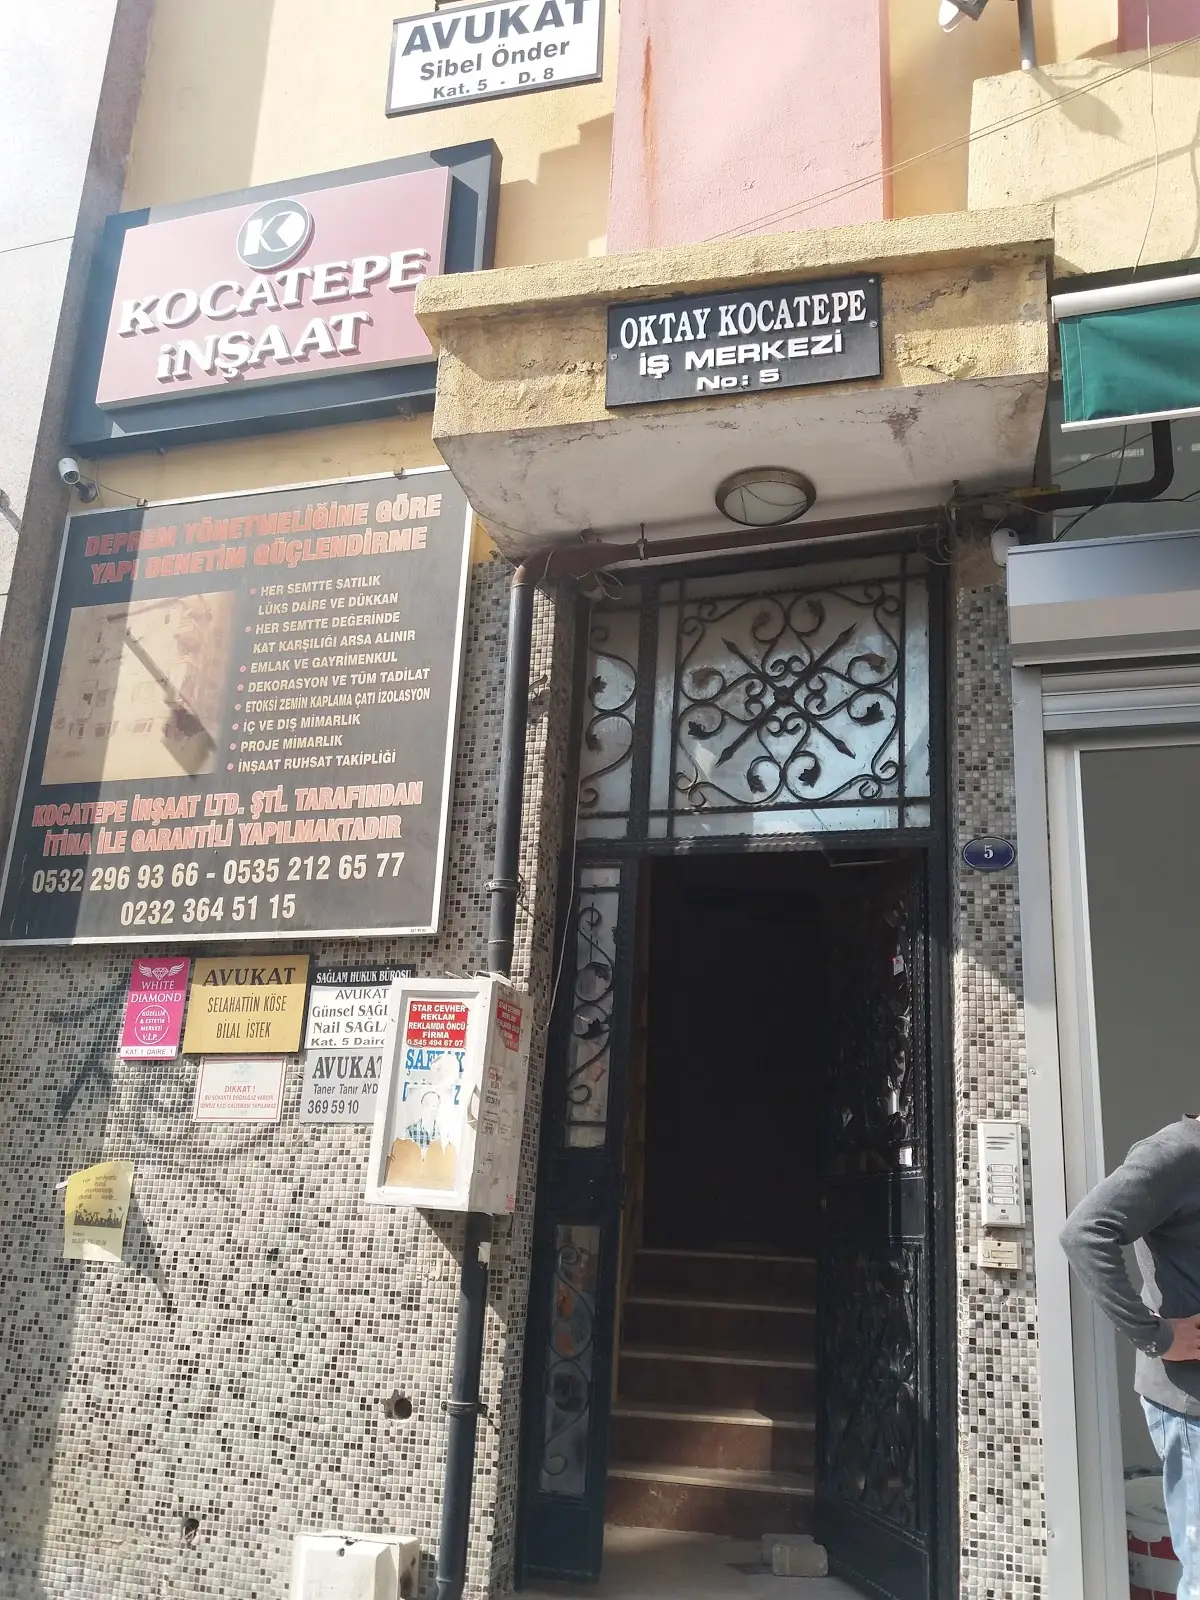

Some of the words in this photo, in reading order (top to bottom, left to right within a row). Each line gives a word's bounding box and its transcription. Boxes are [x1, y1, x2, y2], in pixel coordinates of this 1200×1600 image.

[402, 0, 591, 56] AVUKAT
[420, 53, 482, 80] Sibel
[492, 39, 570, 67] Önder
[433, 83, 469, 99] Kat.
[477, 79, 487, 91] 5
[518, 71, 535, 84] D.
[544, 68, 554, 79] 8
[117, 248, 431, 337] KOCATEPE
[620, 307, 711, 349] OKTAY
[718, 289, 867, 337] KOCATEPE
[639, 353, 669, 379] İŞ
[685, 329, 842, 370] MERKEZİ
[760, 369, 779, 383] 5
[85, 526, 176, 557] DEPREM
[185, 501, 368, 544] YÖNETMELİĞİNE
[376, 492, 443, 523] GÖRE
[91, 561, 139, 585] YAPI
[146, 543, 246, 579] DENETİM
[254, 526, 427, 568] GÜÇLENDİRME
[261, 585, 283, 596] HER
[287, 579, 332, 594] SEMTTE
[336, 575, 381, 589] SATILIK
[258, 602, 288, 616] LÜKS
[292, 598, 326, 612] DAİRE
[331, 598, 345, 608] VE
[348, 593, 398, 607] DÜKKAN
[256, 623, 279, 635] HER
[282, 618, 328, 633] SEMTTE
[332, 611, 400, 628] DEĞERİNDE
[253, 641, 274, 654] KAT
[279, 635, 336, 652] KARŞILIĞI
[340, 634, 371, 646] ARSA
[375, 630, 416, 643] ALINIR
[251, 659, 290, 674] EMLAK
[294, 659, 309, 669] VE
[312, 651, 398, 669] GAYRİMENKUL
[248, 676, 328, 693] DEKORASYON
[332, 675, 347, 686] VE
[351, 671, 376, 685] TÜM
[380, 667, 430, 683] TADİLAT
[279, 694, 308, 711] ZEMİN
[310, 693, 352, 708] KAPLAMA
[355, 692, 375, 708] ÇATI
[378, 687, 430, 704] İZOLASYON
[243, 718, 255, 735] İÇ
[259, 720, 274, 731] VE
[277, 717, 297, 732] DIŞ
[301, 713, 361, 728] MİMARLIK
[240, 739, 279, 752] PROJE
[283, 734, 343, 750] MİMARLIK
[238, 758, 281, 775] İNŞAAT
[284, 756, 332, 769] RUHSAT
[32, 799, 127, 828] KOCATEPE
[132, 793, 198, 827] İNŞAAT
[205, 792, 244, 818] LTD.
[251, 786, 288, 819] ŞTİ.
[295, 781, 423, 811] TARAFINDAN
[42, 830, 91, 857] İTİNA
[97, 826, 127, 854] İLE
[131, 819, 233, 852] GARANTİLİ
[239, 814, 402, 846] YAPILMAKTADIR
[984, 845, 993, 858] 5
[32, 868, 83, 893] 0532
[90, 866, 130, 891] 296
[137, 864, 165, 889] 93
[172, 861, 199, 887] 66
[223, 858, 280, 884] 0535
[286, 856, 330, 881] 212
[339, 854, 367, 879] 65
[376, 852, 405, 877] 77
[120, 900, 174, 926] 0232
[183, 898, 224, 922] 364
[232, 896, 258, 920] 51
[270, 893, 296, 919] 15
[141, 981, 174, 990] WHITE
[202, 967, 296, 987] AVUKAT
[316, 969, 348, 983] SAĞLAM
[350, 971, 378, 983] HUKUK
[379, 967, 411, 982] BÜROSU
[131, 993, 181, 1002] DIAMOND
[207, 993, 260, 1013] SELAHATTİN
[264, 994, 288, 1012] KÖSE
[335, 989, 389, 1000] AVUKAT
[312, 1005, 354, 1017] Günsel
[358, 1001, 388, 1016] SAĞL
[412, 1004, 432, 1012] STAR
[216, 1019, 241, 1039] BİLAL
[246, 1019, 271, 1038] İSTEK
[314, 1022, 340, 1033] Nail
[345, 1018, 388, 1033] SAĞL
[408, 1022, 444, 1030] REKLAMDA
[447, 1021, 465, 1030] ÖNCÜ
[311, 1038, 336, 1046] Kat.
[314, 1084, 335, 1094] Taner
[362, 1083, 378, 1094] AYD
[308, 1100, 329, 1114] 369
[331, 1100, 345, 1114] 59
[348, 1100, 359, 1114] 10
